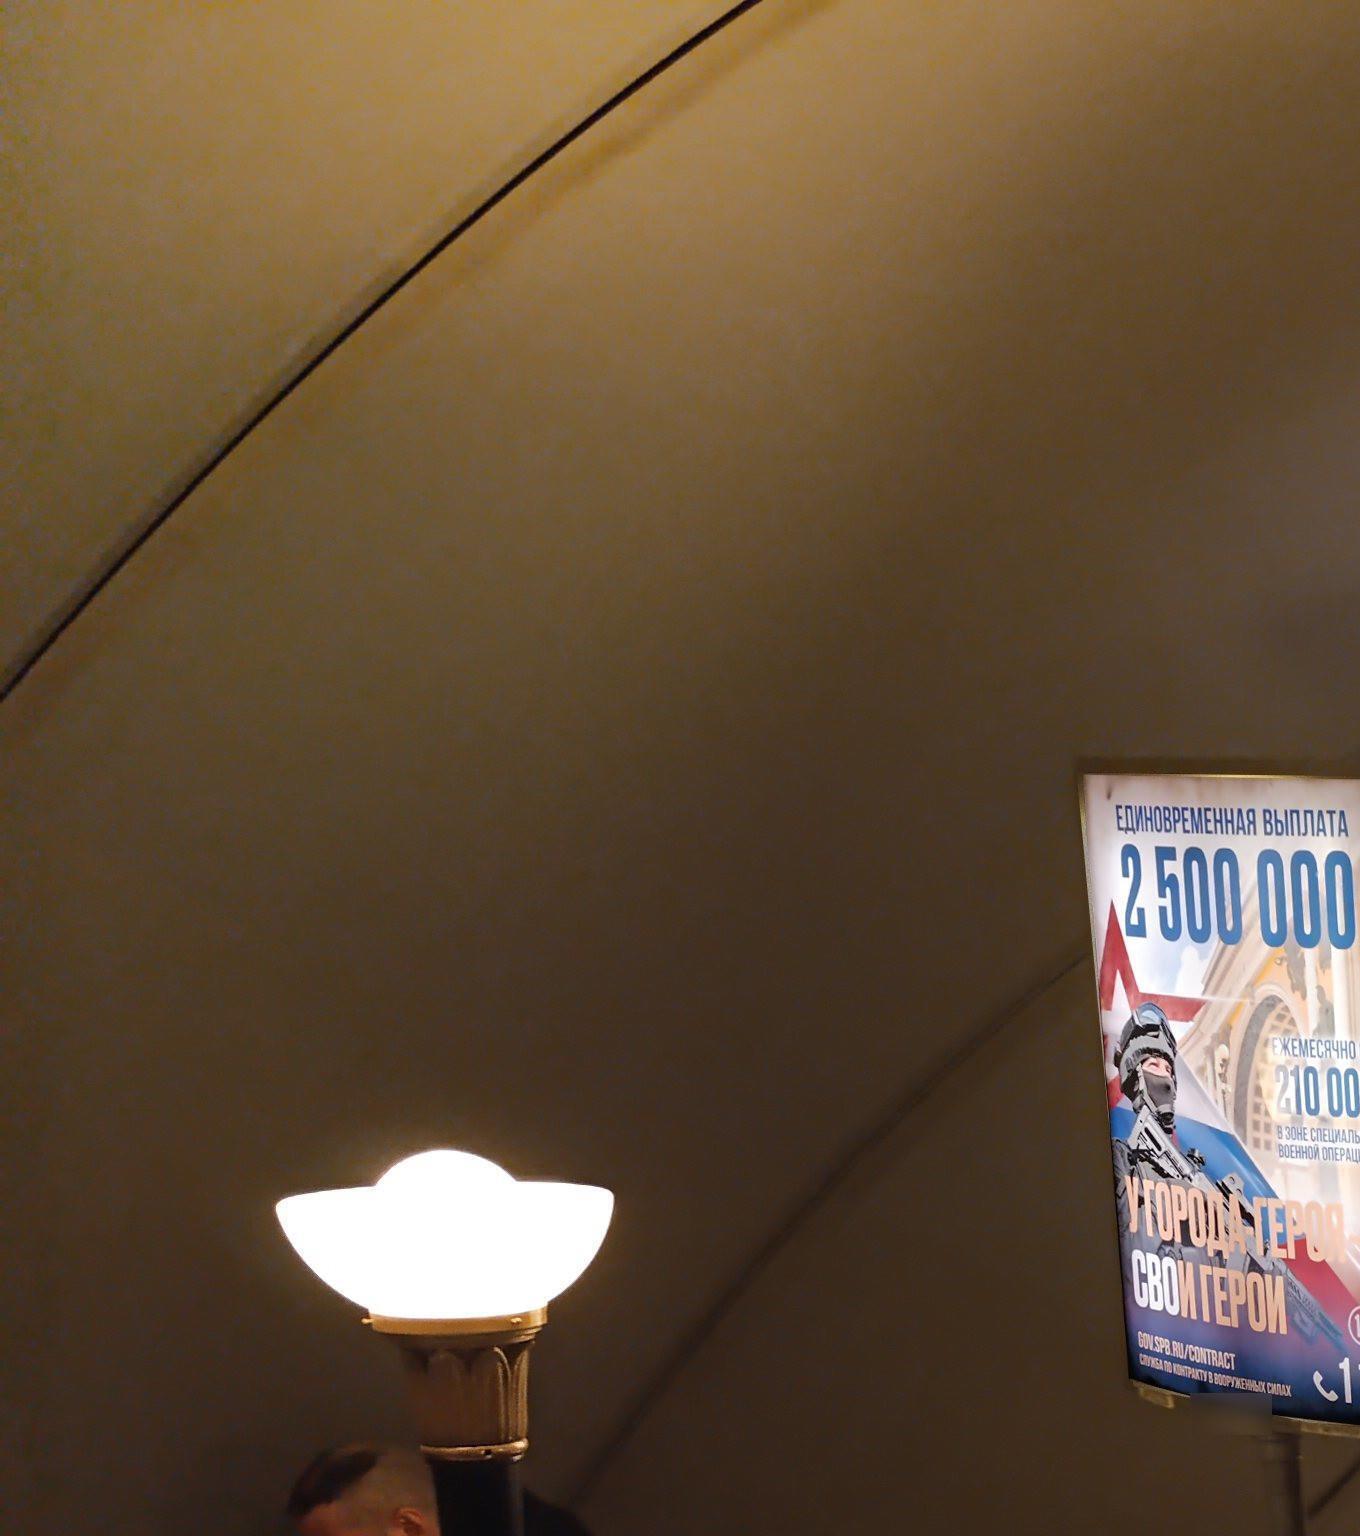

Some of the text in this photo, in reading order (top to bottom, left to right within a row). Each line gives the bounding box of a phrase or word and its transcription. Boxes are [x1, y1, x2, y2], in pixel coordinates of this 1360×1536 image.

[1115, 804, 1349, 837] ЕДИНОВРЕМЕННАЯ ВЫПЛАТА
[1121, 843, 1356, 949] 2 500 000
[1272, 1037, 1356, 1059] ЕЖЕМЕСЯЧНО
[1274, 1064, 1320, 1116] 210
[1277, 1125, 1283, 1140] В
[1285, 1126, 1308, 1142] ЗОНЕ
[1278, 1143, 1320, 1160] ВОЕННОЙ
[1124, 1175, 1139, 1233] У
[1131, 1249, 1288, 1335] СВОИ ГЕРОИ
[1137, 1330, 1236, 1371] GOV.SPB.RU/CONTRACT
[1163, 1361, 1173, 1374] ПО
[1172, 1363, 1207, 1383] КОНТРАКТУ
[1213, 1373, 1267, 1394] ВООРУЖЕННЫХ
[1266, 1382, 1292, 1398] СИЛАХ
